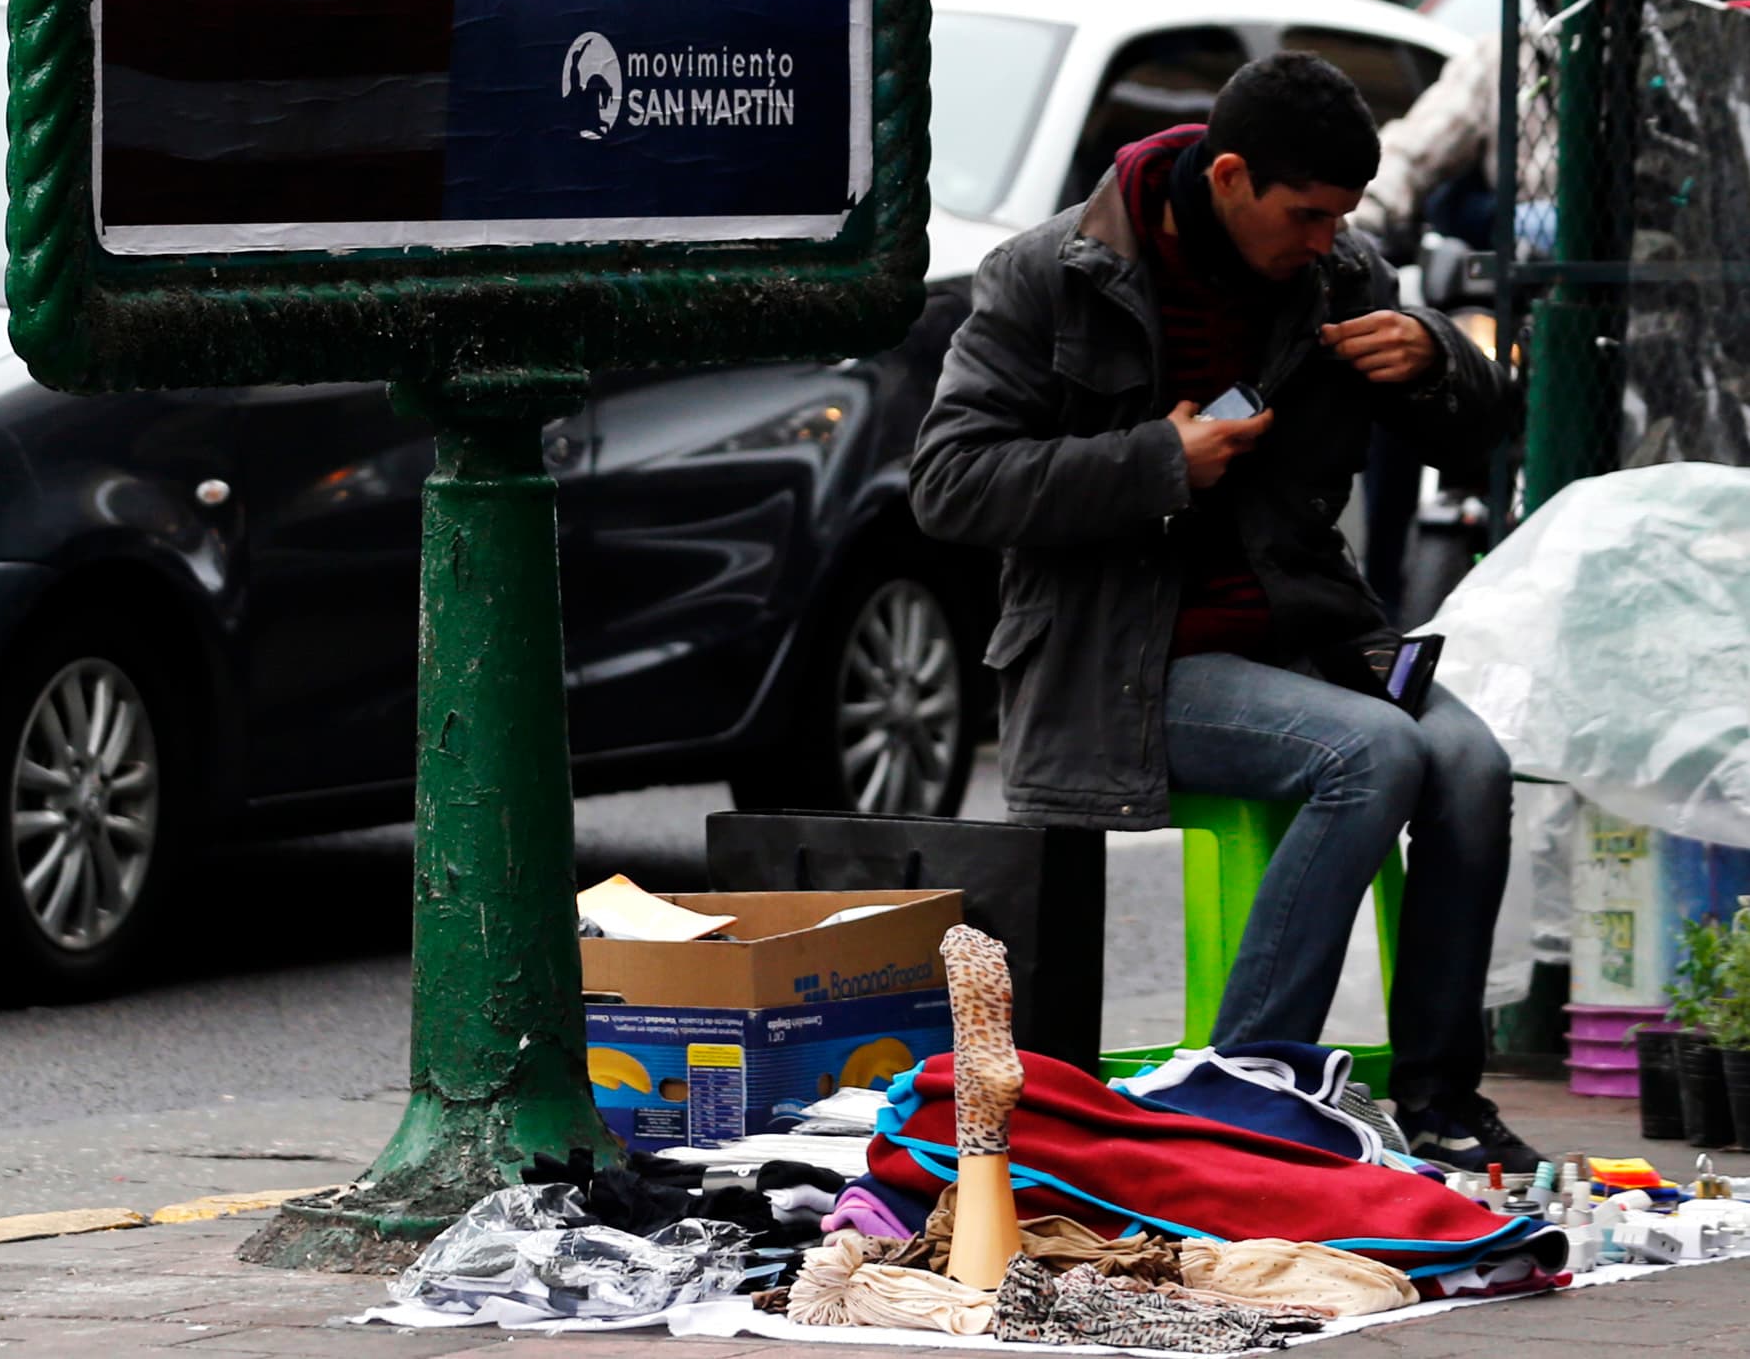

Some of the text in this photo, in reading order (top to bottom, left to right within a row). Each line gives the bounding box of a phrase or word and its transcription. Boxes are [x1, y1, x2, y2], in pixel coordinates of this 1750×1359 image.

[628, 45, 793, 77] movimiento
[628, 78, 794, 126] SAN MARTÍN
